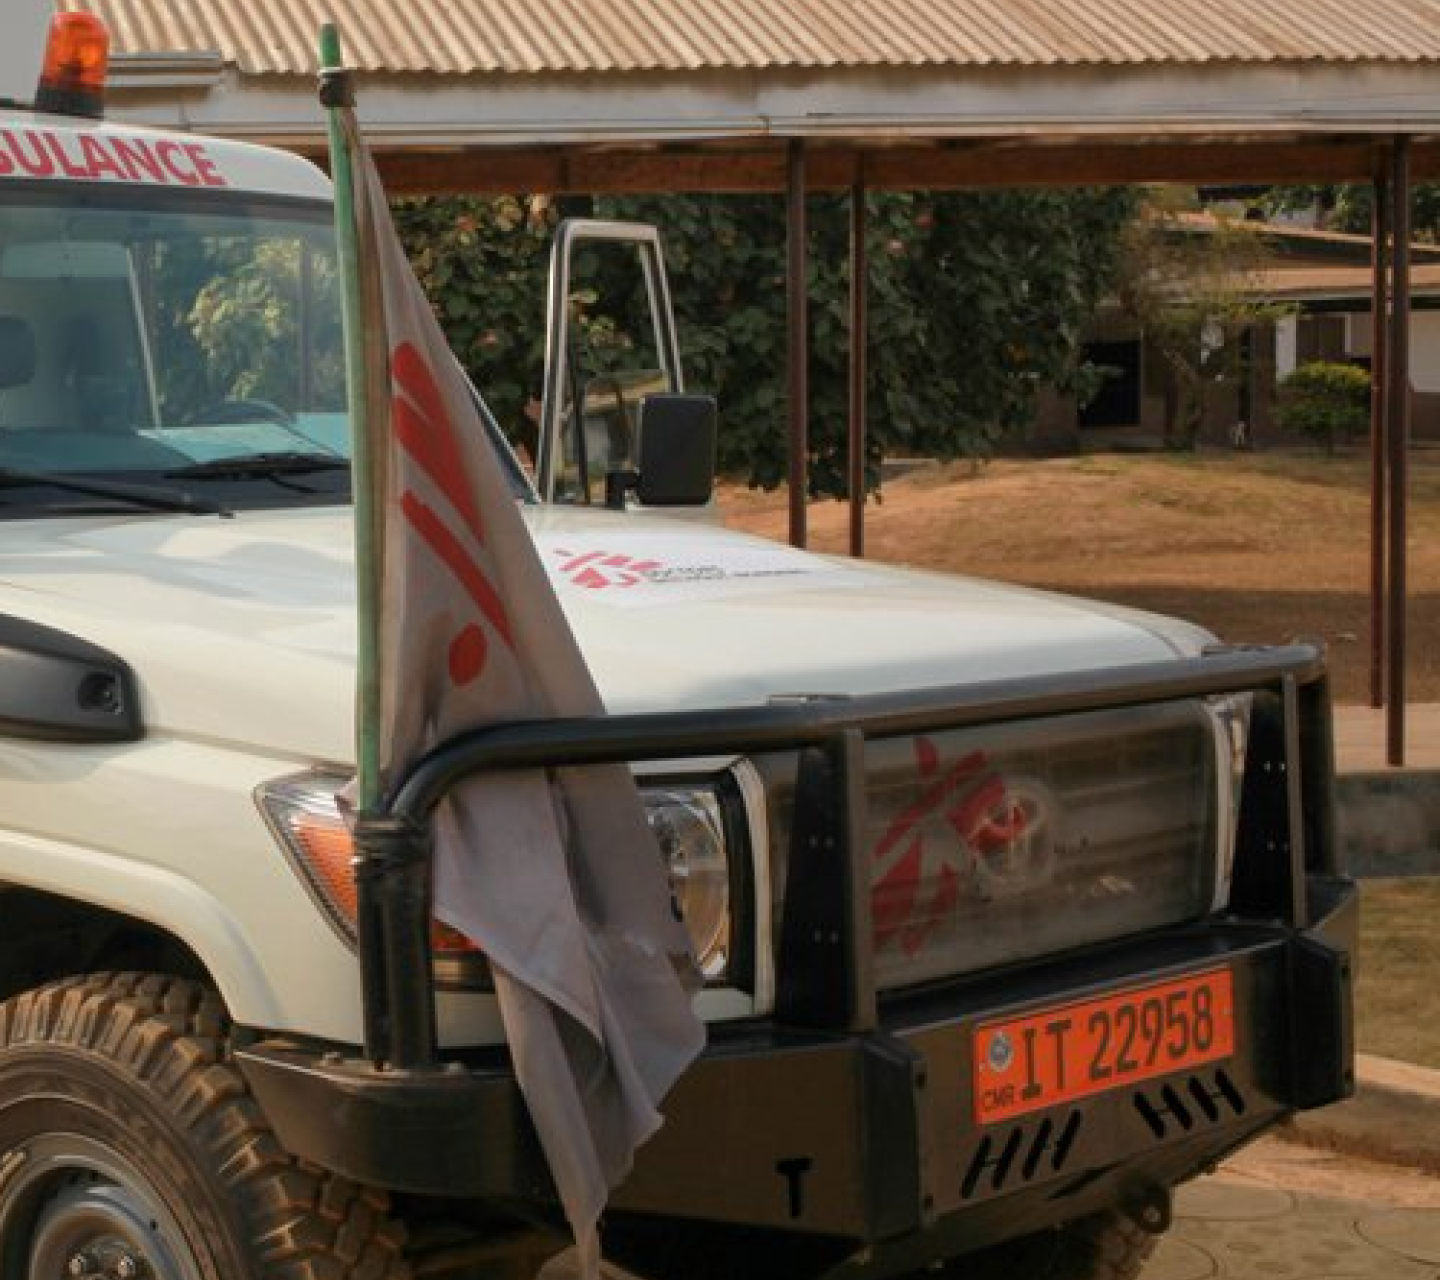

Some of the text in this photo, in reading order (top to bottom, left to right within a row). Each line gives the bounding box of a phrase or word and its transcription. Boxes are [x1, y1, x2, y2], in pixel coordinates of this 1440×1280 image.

[1022, 984, 1213, 1100] IT 22958
[984, 1084, 1015, 1111] CMR
